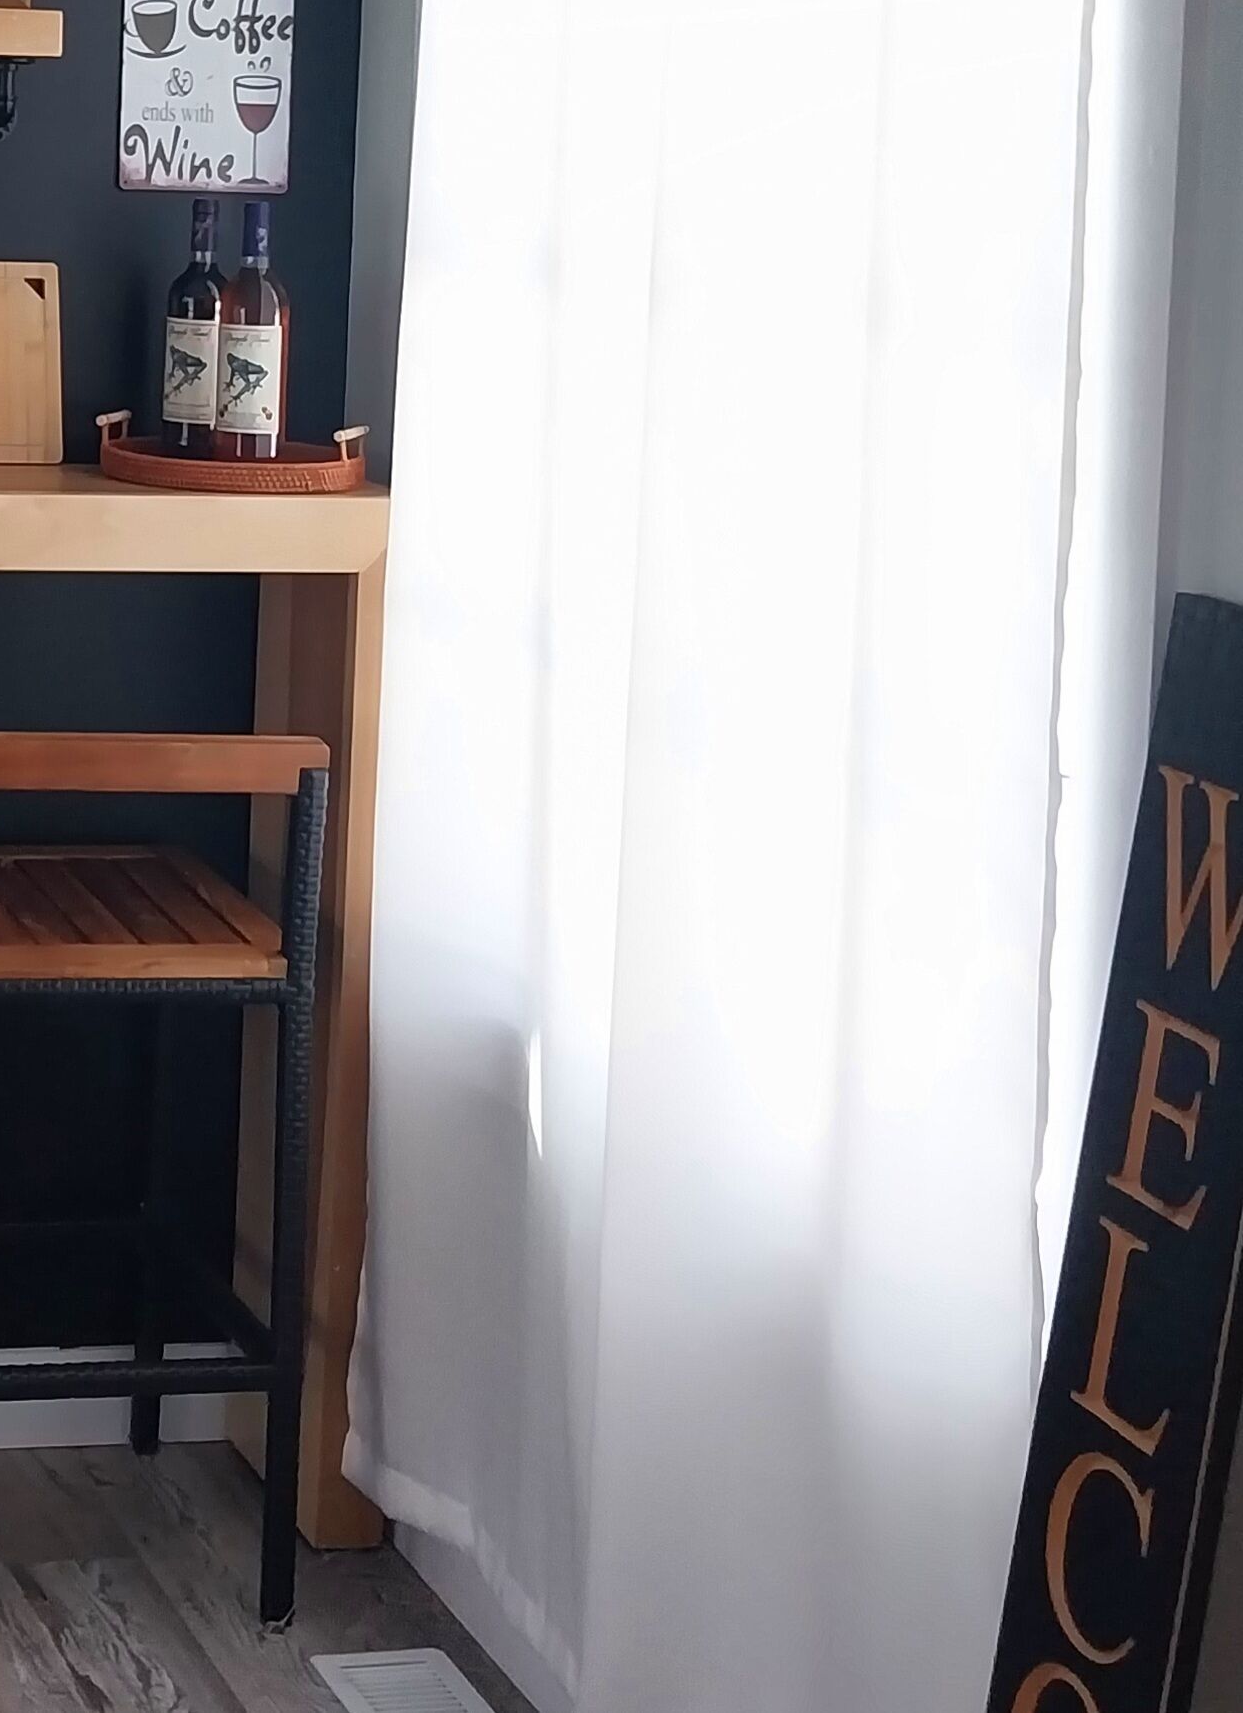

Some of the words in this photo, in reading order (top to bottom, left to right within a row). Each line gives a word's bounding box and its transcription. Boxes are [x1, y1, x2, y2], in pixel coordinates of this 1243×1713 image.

[164, 66, 194, 98] &
[141, 101, 177, 123] ends
[181, 102, 215, 124] with
[123, 123, 235, 184] Wine
[1010, 763, 1243, 1713] WELC
